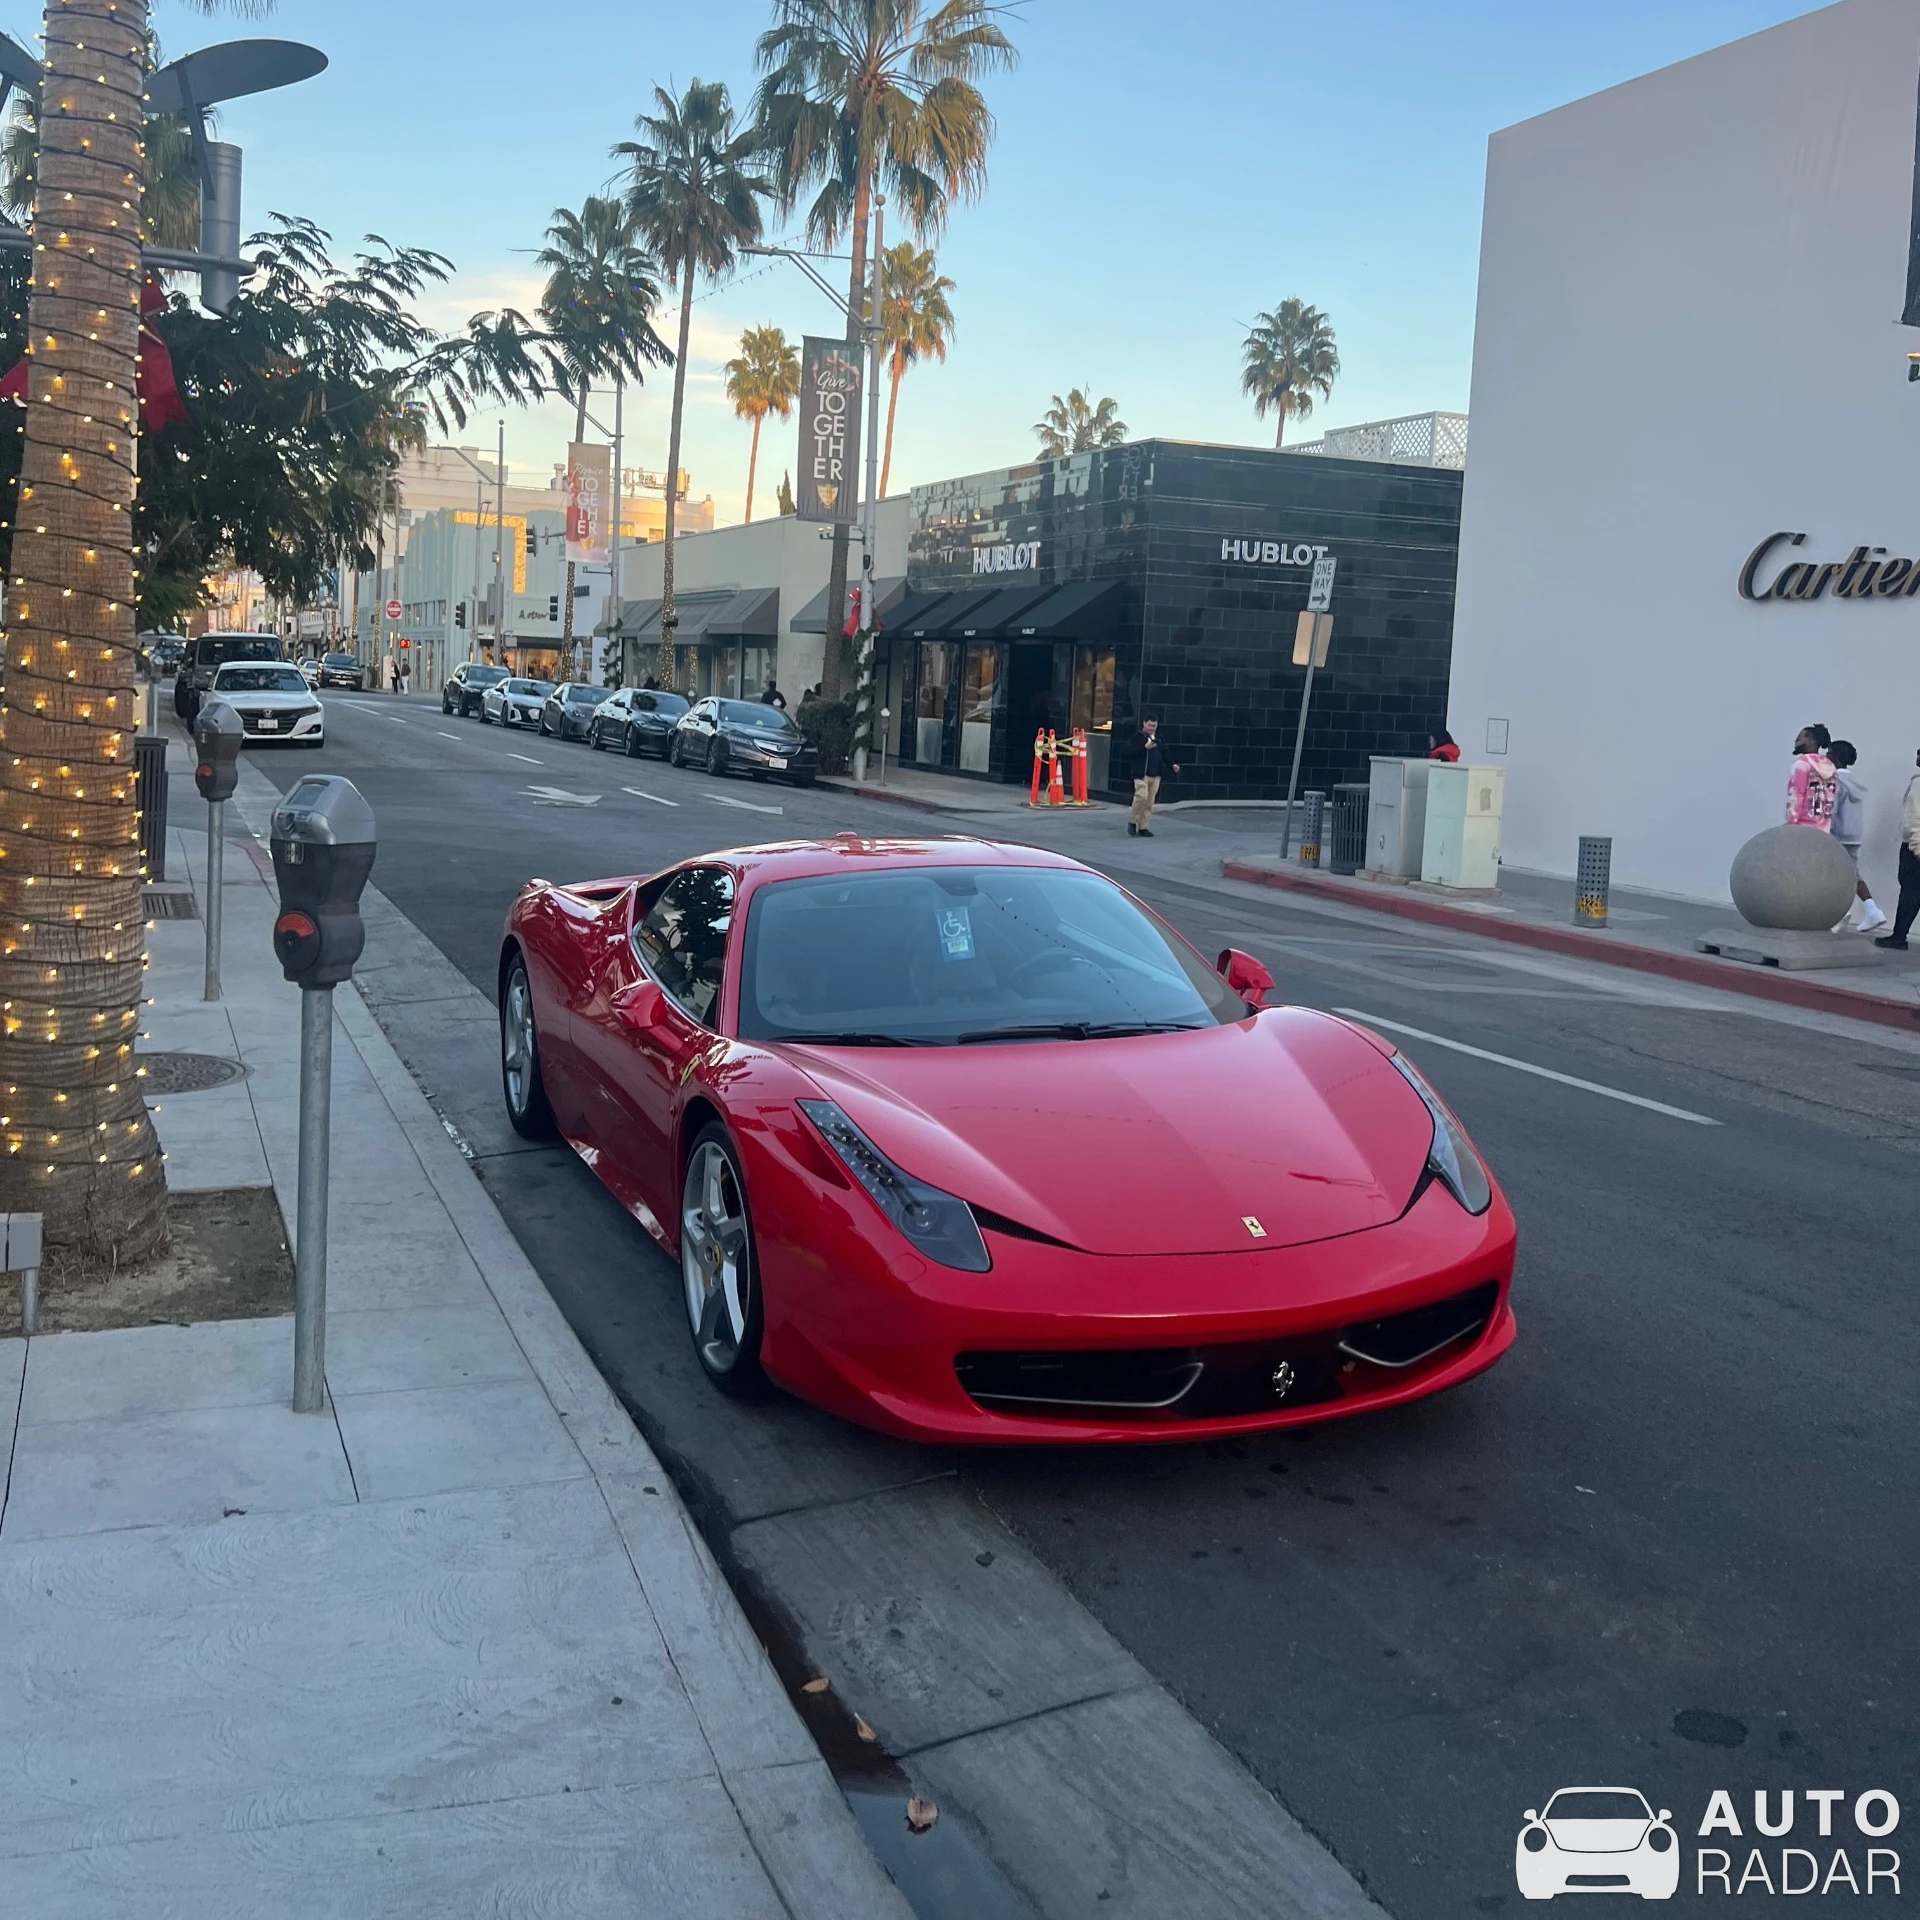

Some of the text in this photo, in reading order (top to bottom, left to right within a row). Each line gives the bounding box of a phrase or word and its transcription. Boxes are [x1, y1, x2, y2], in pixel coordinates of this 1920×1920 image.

[817, 370, 847, 390] Give
[816, 391, 846, 414] TO
[813, 414, 845, 437] GE
[814, 436, 844, 459] TH
[813, 458, 843, 481] ER
[579, 477, 599, 492] TO
[576, 492, 598, 507] GE
[578, 507, 598, 521] TH
[577, 520, 597, 535] ER
[972, 541, 1042, 574] HUBLOT
[1221, 538, 1329, 566] HUBLOT
[1315, 562, 1333, 576] ONE
[1313, 577, 1331, 590] WAY
